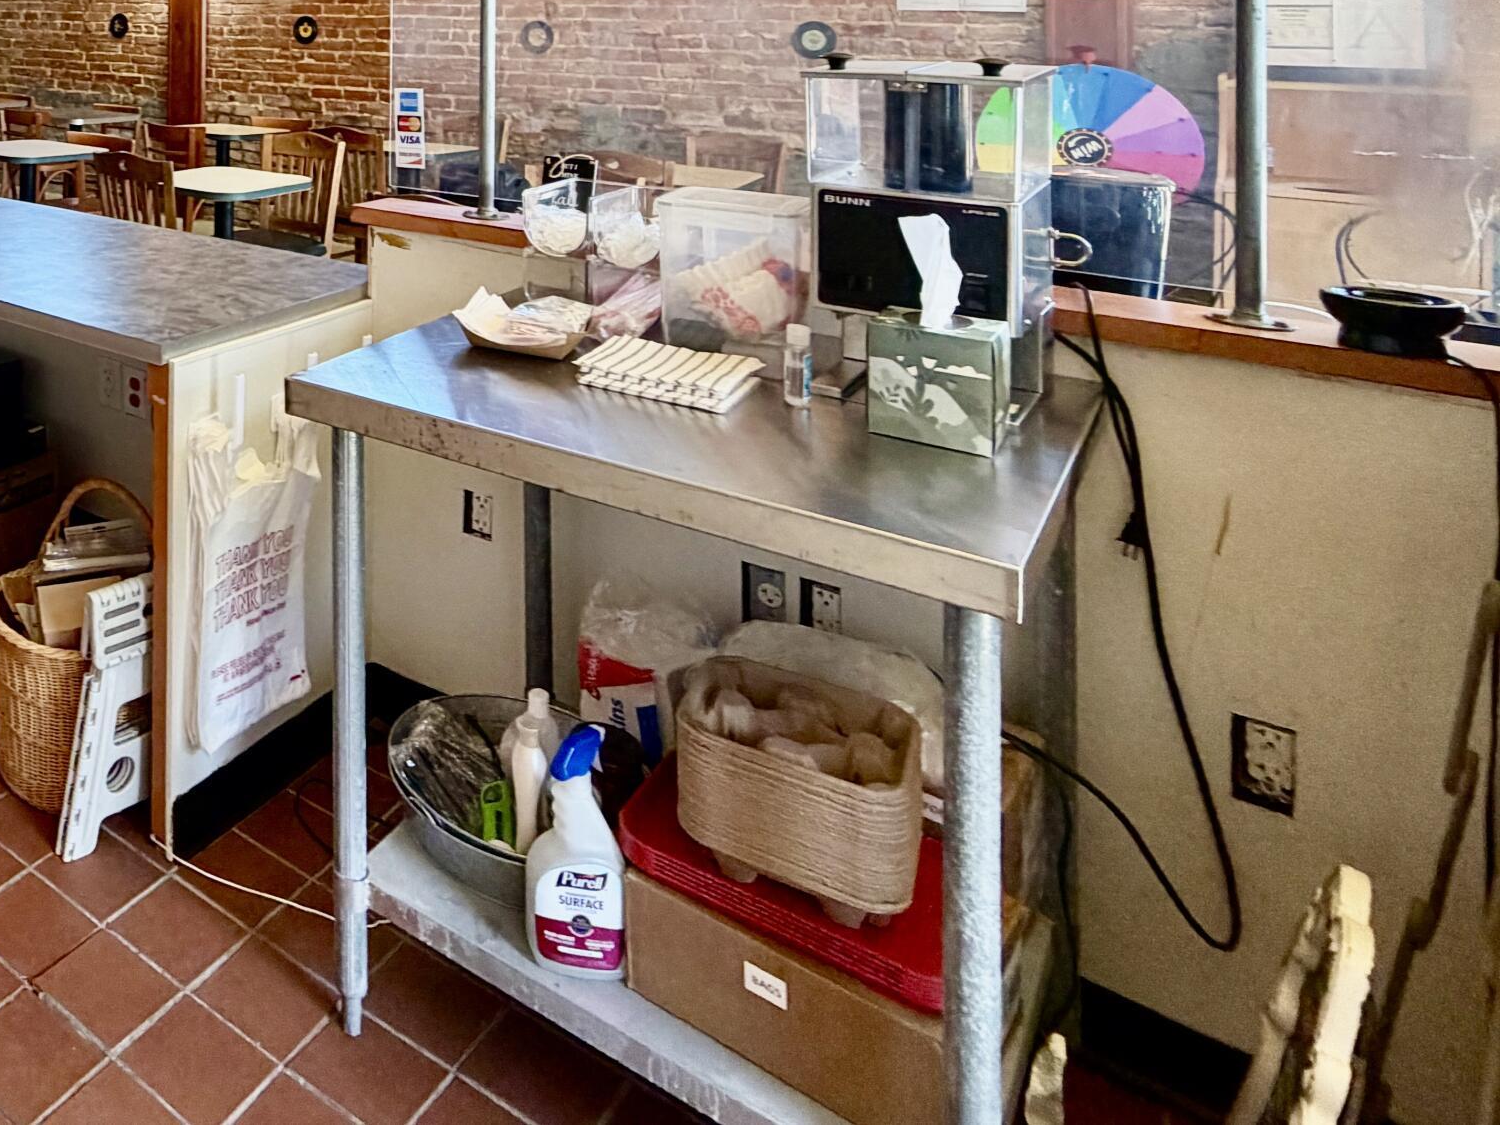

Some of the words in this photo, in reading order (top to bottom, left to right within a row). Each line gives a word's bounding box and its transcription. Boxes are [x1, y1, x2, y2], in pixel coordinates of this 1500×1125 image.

[400, 135, 421, 144] VISA
[1070, 140, 1103, 160] WIN
[823, 194, 872, 207] BUNN
[214, 561, 258, 606] THANK
[260, 549, 293, 580] YOU
[212, 585, 260, 633] THANK
[260, 573, 290, 606] YOU
[558, 894, 604, 911] SURFACE
